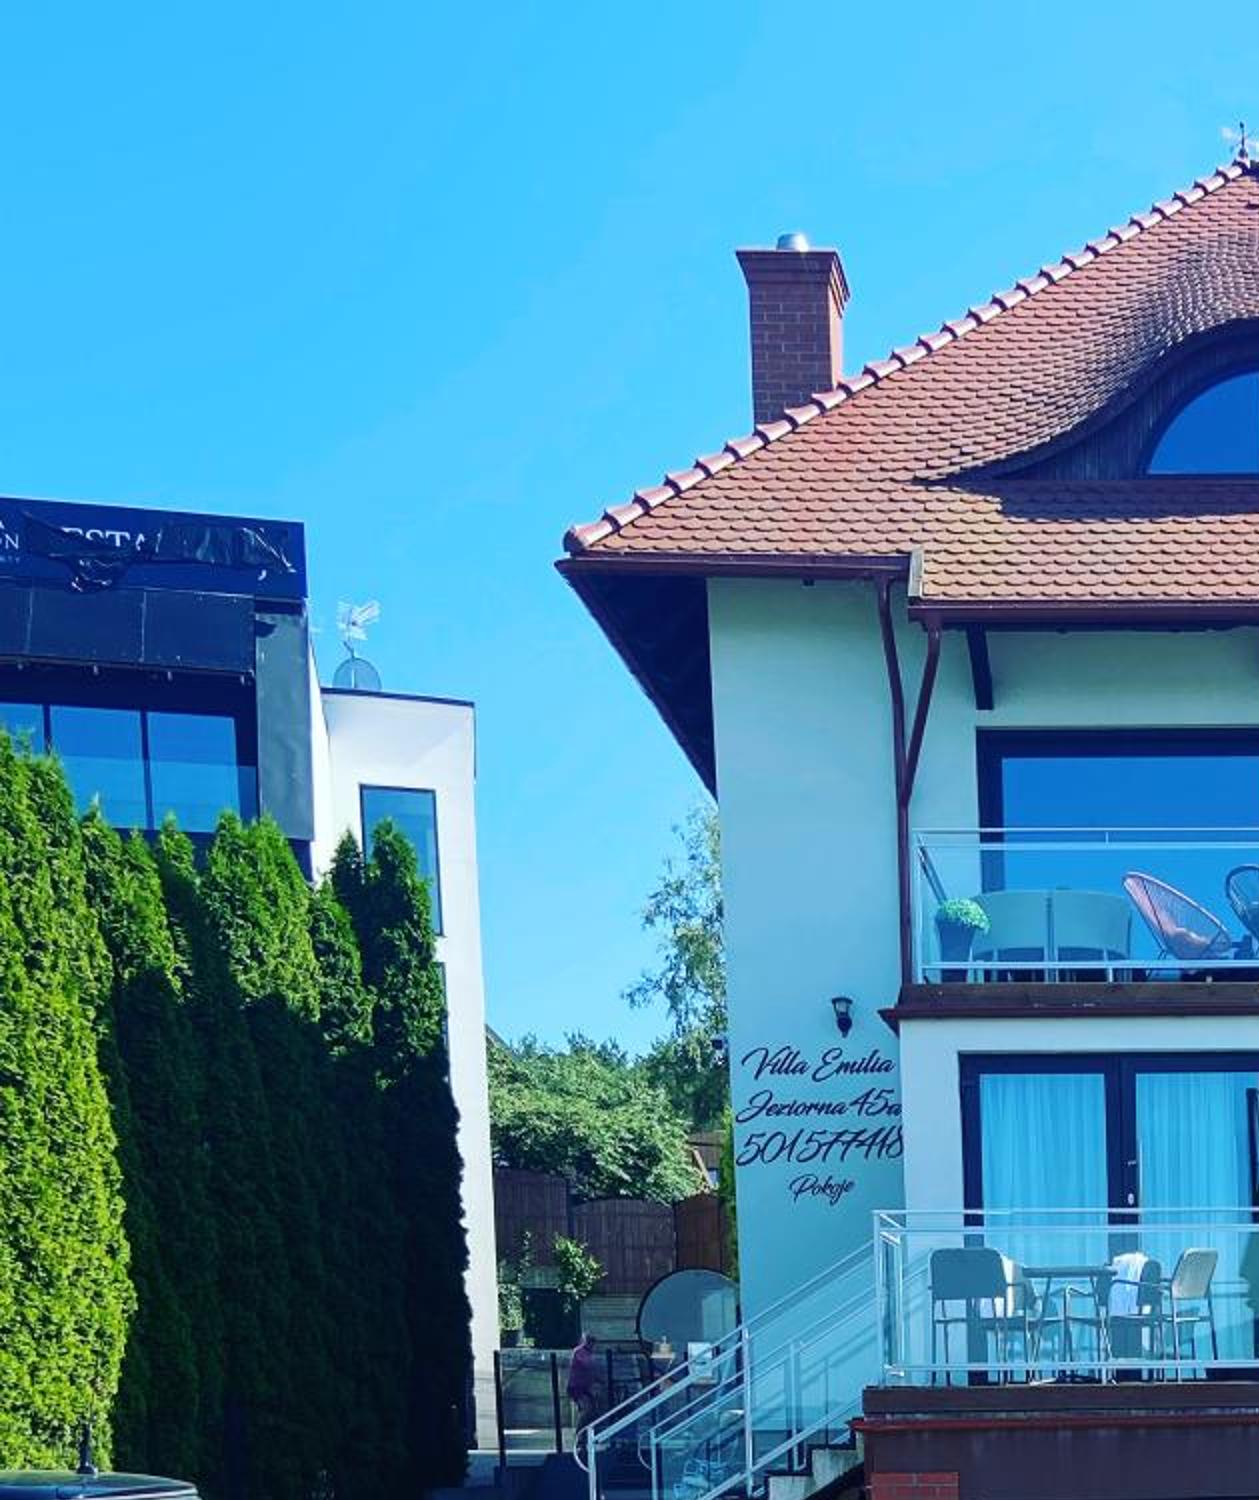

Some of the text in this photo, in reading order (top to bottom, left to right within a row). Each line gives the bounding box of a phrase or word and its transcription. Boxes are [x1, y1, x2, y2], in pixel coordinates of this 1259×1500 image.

[741, 1046, 895, 1082] Villa Emilia
[736, 1087, 902, 1123] Jeziorna 45a
[789, 1173, 855, 1206] Pokoje
